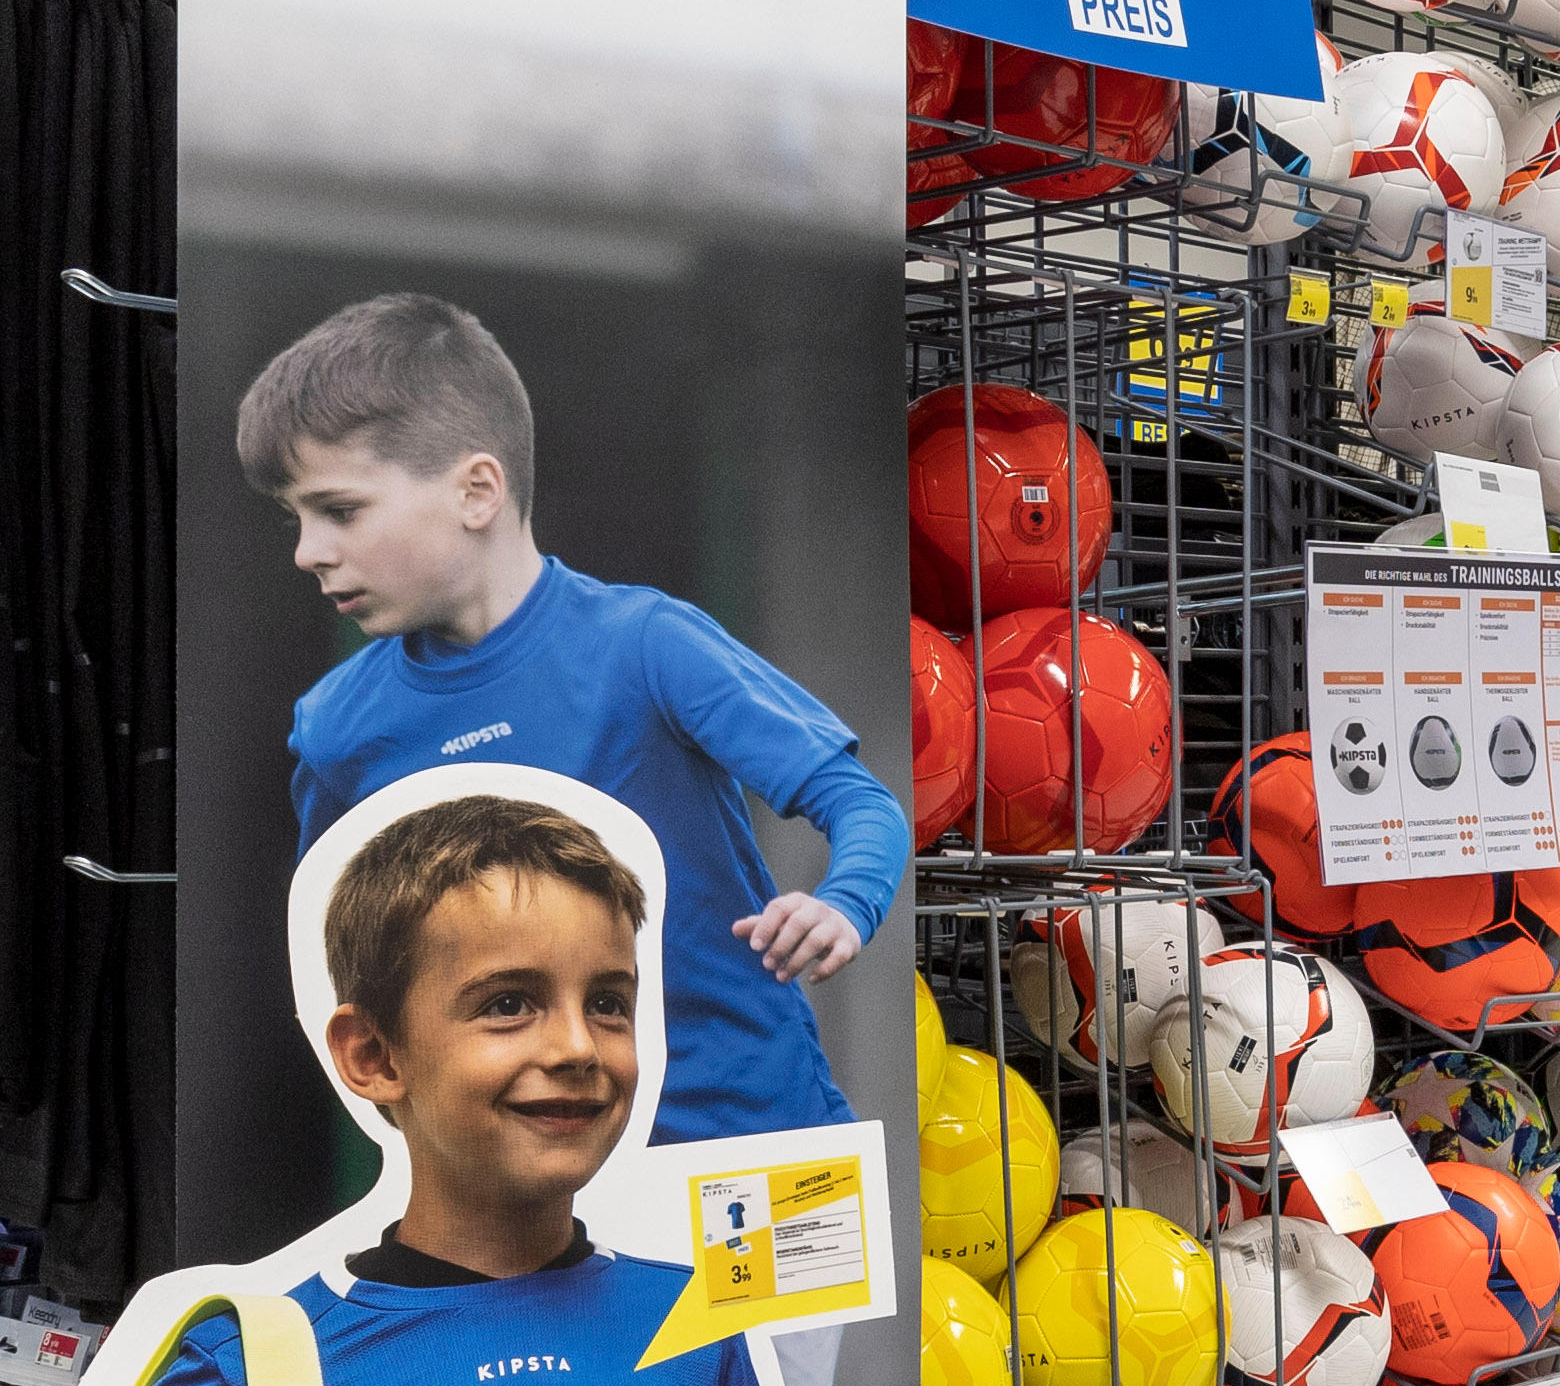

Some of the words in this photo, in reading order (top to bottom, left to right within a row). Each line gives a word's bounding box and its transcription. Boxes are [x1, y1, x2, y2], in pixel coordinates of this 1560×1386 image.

[1466, 286, 1472, 302] 9
[1302, 302, 1309, 315] 3
[1382, 305, 1389, 320] 2
[1411, 406, 1476, 430] KIPSTA
[1365, 570, 1377, 580] DIE
[1378, 570, 1412, 582] RICHTIGE
[1413, 571, 1432, 582] WAHL
[1434, 572, 1448, 583] DES
[795, 1171, 831, 1190] EINSTEIGER
[703, 1188, 732, 1197] KIPSTA
[731, 1264, 742, 1284] 3
[477, 1354, 571, 1382] KIPSTA
